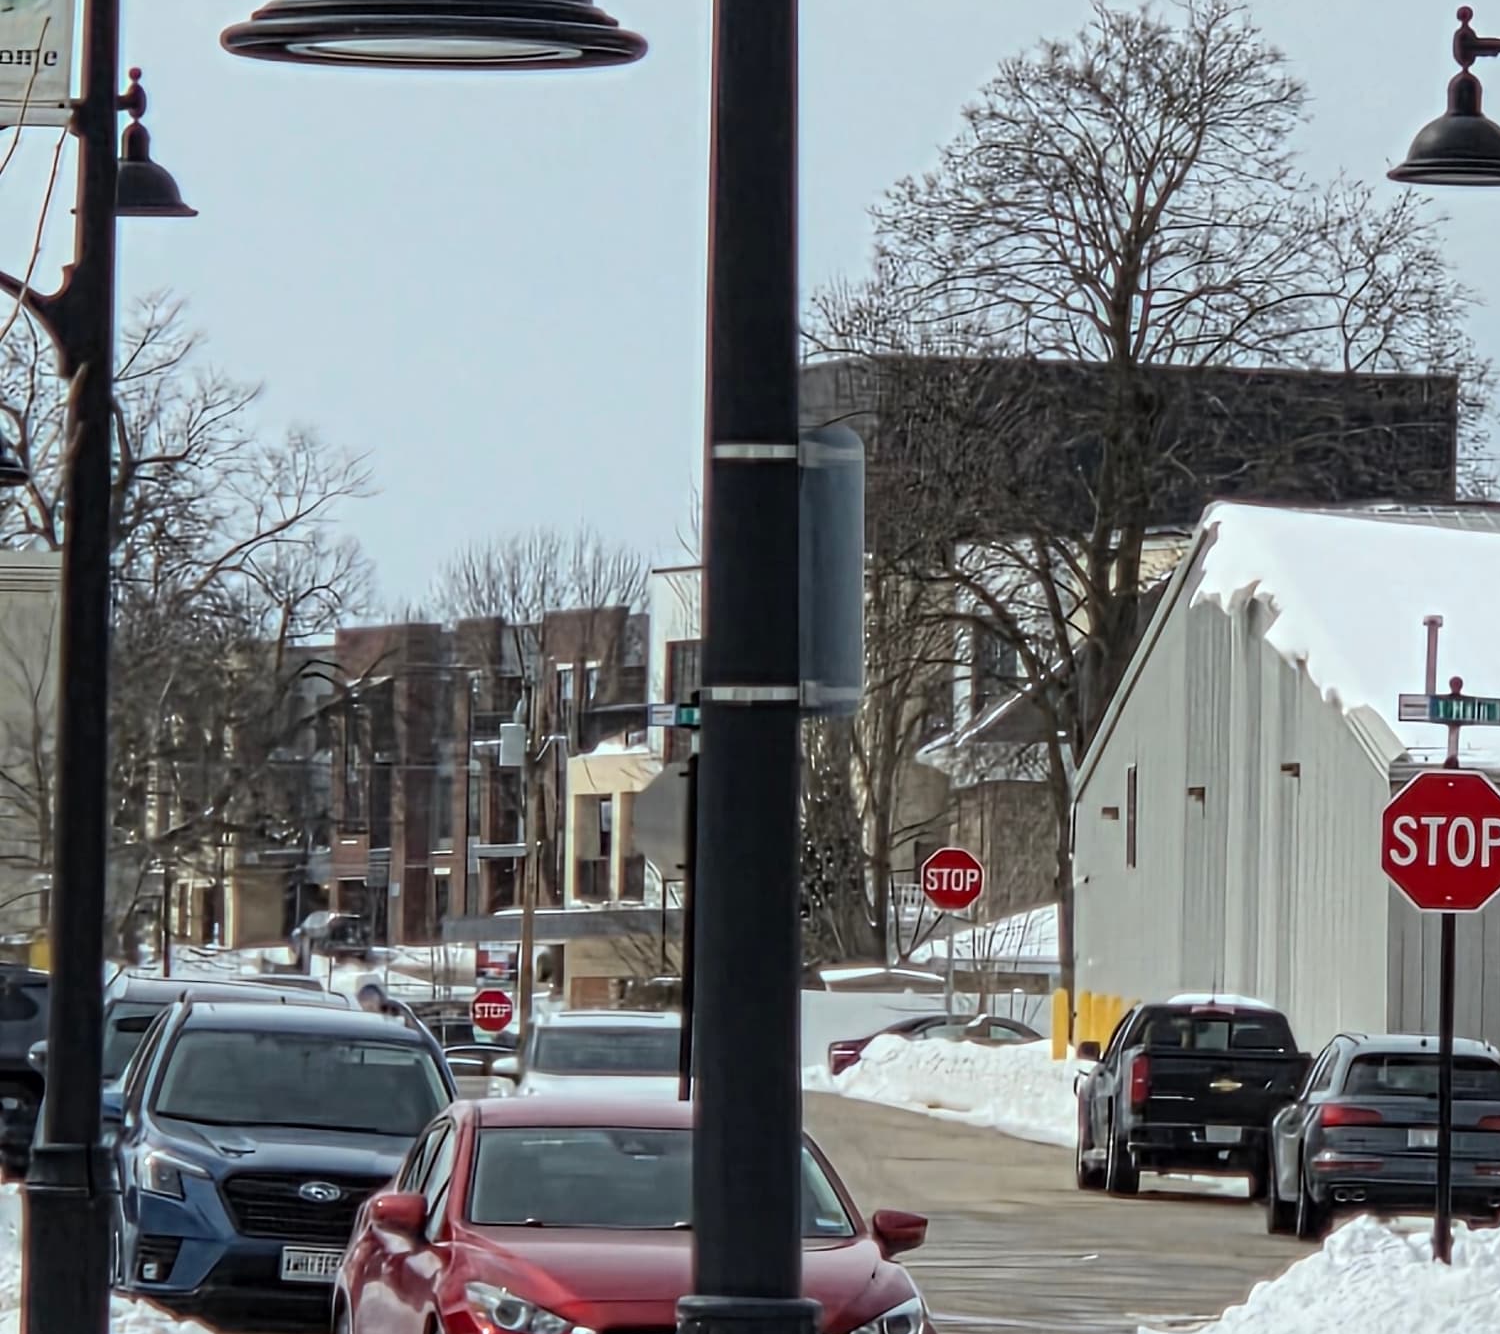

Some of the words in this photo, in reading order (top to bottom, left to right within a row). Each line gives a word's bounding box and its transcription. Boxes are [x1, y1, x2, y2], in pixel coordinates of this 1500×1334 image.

[0, 49, 58, 67] ome
[925, 868, 980, 892] STOP
[474, 1002, 512, 1019] STOP
